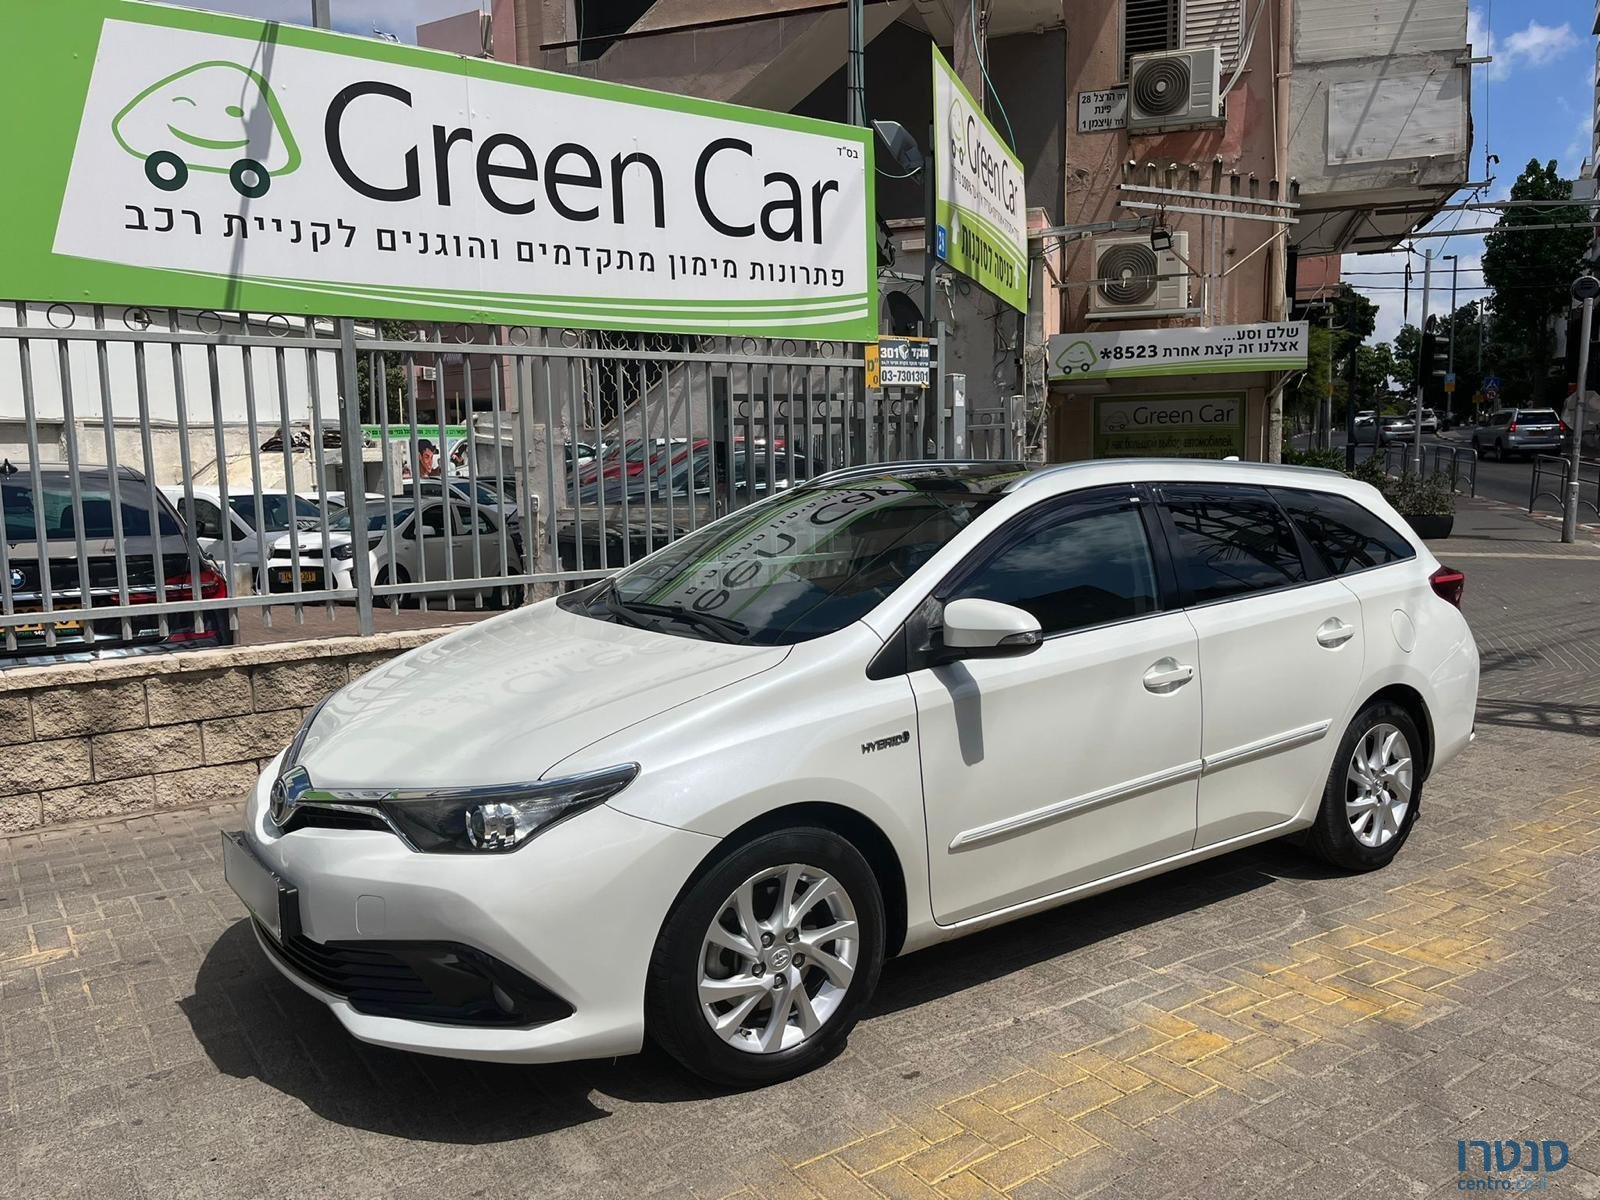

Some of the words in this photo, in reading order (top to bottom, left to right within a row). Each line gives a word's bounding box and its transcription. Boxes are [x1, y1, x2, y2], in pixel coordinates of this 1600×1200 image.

[1081, 96, 1091, 104] 28
[1093, 92, 1115, 102] הרצל
[1094, 105, 1112, 115] פינת
[1082, 120, 1087, 128] 1
[325, 81, 665, 228] Green
[694, 137, 839, 245] Car
[967, 114, 1001, 201] Green
[1001, 158, 1018, 217] Car
[125, 204, 202, 235] רכב
[223, 212, 357, 252] לקניית
[377, 228, 499, 260] והוגנים
[516, 240, 655, 274] מתקדמים
[668, 254, 738, 279] מימון
[994, 251, 1013, 289] כניסה
[750, 261, 844, 287] פתרונות
[1222, 330, 1262, 341] וסע...
[1267, 326, 1299, 339] שלם
[880, 347, 900, 358] 301
[1162, 346, 1201, 357] אחרת
[1204, 344, 1234, 357] קצת
[1238, 343, 1254, 354] זה
[1259, 340, 1299, 353] אצלנו
[881, 370, 929, 382] 03-7301301
[1133, 406, 1193, 425] Green
[1199, 404, 1235, 423] Car
[861, 734, 903, 755] HYBRID
